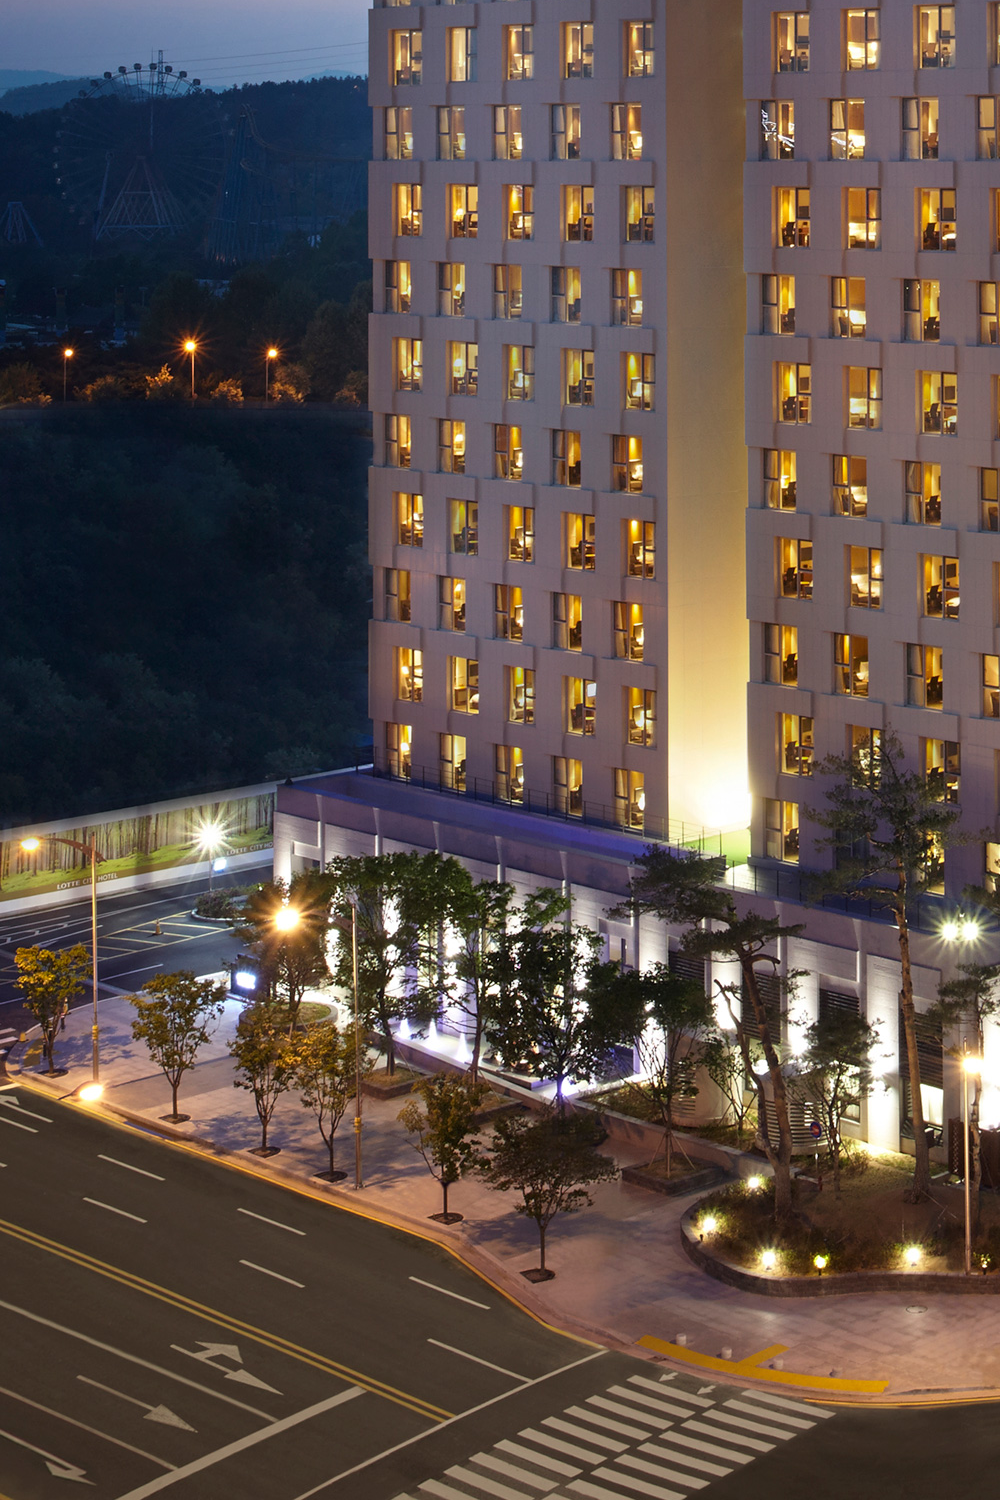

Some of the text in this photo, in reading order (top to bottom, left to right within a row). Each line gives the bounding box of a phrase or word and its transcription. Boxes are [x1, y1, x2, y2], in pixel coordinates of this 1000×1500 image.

[226, 847, 247, 856] LOTTE
[249, 843, 263, 851] CITY
[56, 872, 118, 890] LOTTE CIT HOTEL
